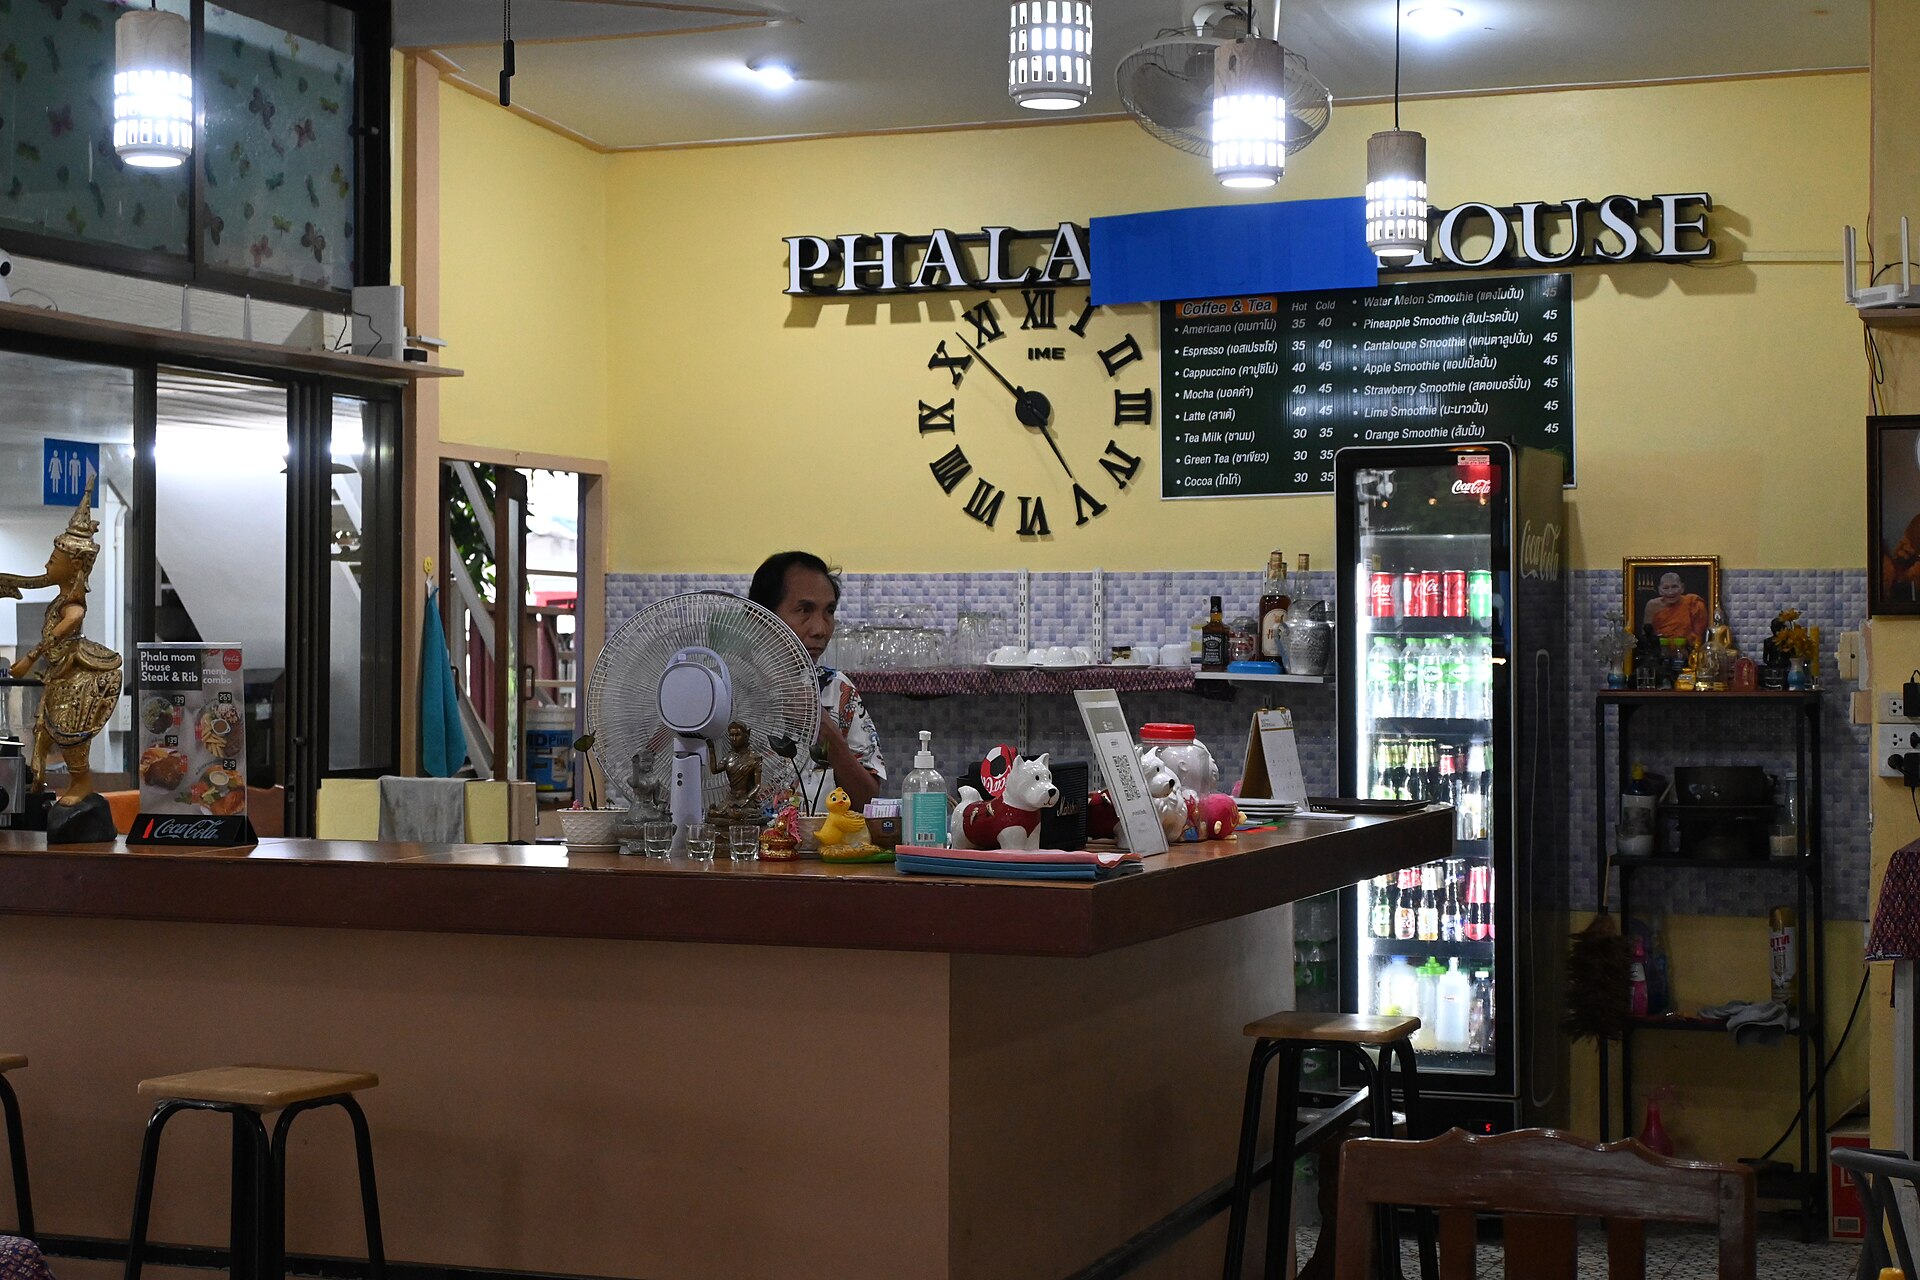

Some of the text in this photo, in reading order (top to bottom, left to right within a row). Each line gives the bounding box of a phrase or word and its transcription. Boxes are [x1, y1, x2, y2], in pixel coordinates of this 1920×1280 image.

[782, 193, 1712, 293] PHALA OUSE
[1364, 295, 1392, 307] Water
[1394, 294, 1424, 305] Melon
[1427, 291, 1473, 304] Smoothie
[1543, 287, 1557, 298] 45
[1020, 289, 1057, 329] XII
[1182, 300, 1336, 316] Coffee & Tea Hot Cold
[962, 300, 1004, 349] XI
[1182, 323, 1231, 335] Americano
[1291, 319, 1307, 329] 35
[1317, 317, 1332, 327] 40
[1363, 316, 1410, 330] Pineapple
[1413, 313, 1459, 327] Smoothie
[1543, 310, 1558, 320] 45
[1182, 346, 1224, 358] Espresso
[1291, 340, 1307, 351] 35
[1318, 339, 1332, 349] 40
[1363, 339, 1417, 351] Cantaloupe
[1419, 336, 1466, 348] Smoothie
[1543, 332, 1558, 343] 45
[928, 340, 973, 386] X
[1097, 333, 1143, 377] II
[1182, 365, 1236, 380] Cappuccino
[1292, 362, 1306, 373] 40
[1318, 361, 1332, 371] 45
[1363, 363, 1391, 375] Apple
[1393, 360, 1440, 371] Smoothie
[1543, 355, 1558, 365] 45
[1183, 389, 1214, 400] Mocha
[1292, 384, 1306, 395] 40
[1318, 383, 1333, 393] 45
[1364, 384, 1417, 396] Strawberry
[1419, 382, 1466, 393] Smoothie
[1544, 378, 1558, 388] 45
[918, 398, 955, 434] IX
[1114, 388, 1152, 426] III
[1183, 411, 1206, 422] Latte
[1292, 406, 1307, 417] 40
[1319, 405, 1333, 415] 45
[1364, 407, 1388, 418] Lime
[1391, 405, 1437, 417] Smoothie
[1544, 400, 1559, 411] 45
[1184, 427, 1333, 443] Tea Milk (ชานม) 30 35
[1365, 429, 1399, 442] Orange
[1402, 427, 1448, 439] Smoothie
[1544, 423, 1559, 433] 45
[1099, 440, 1142, 489] IV
[1184, 454, 1211, 465] Green
[1214, 453, 1229, 464] Tea
[1293, 450, 1307, 461] 30
[1320, 449, 1334, 460] 35
[1184, 471, 1334, 487] Cocoa (โกโก้) 30 35
[1072, 482, 1107, 526] V
[1016, 496, 1051, 535] VI
[140, 651, 168, 662] Phala
[141, 661, 171, 672] House
[141, 671, 198, 682] Steak & Rib
[202, 676, 232, 684] combo
